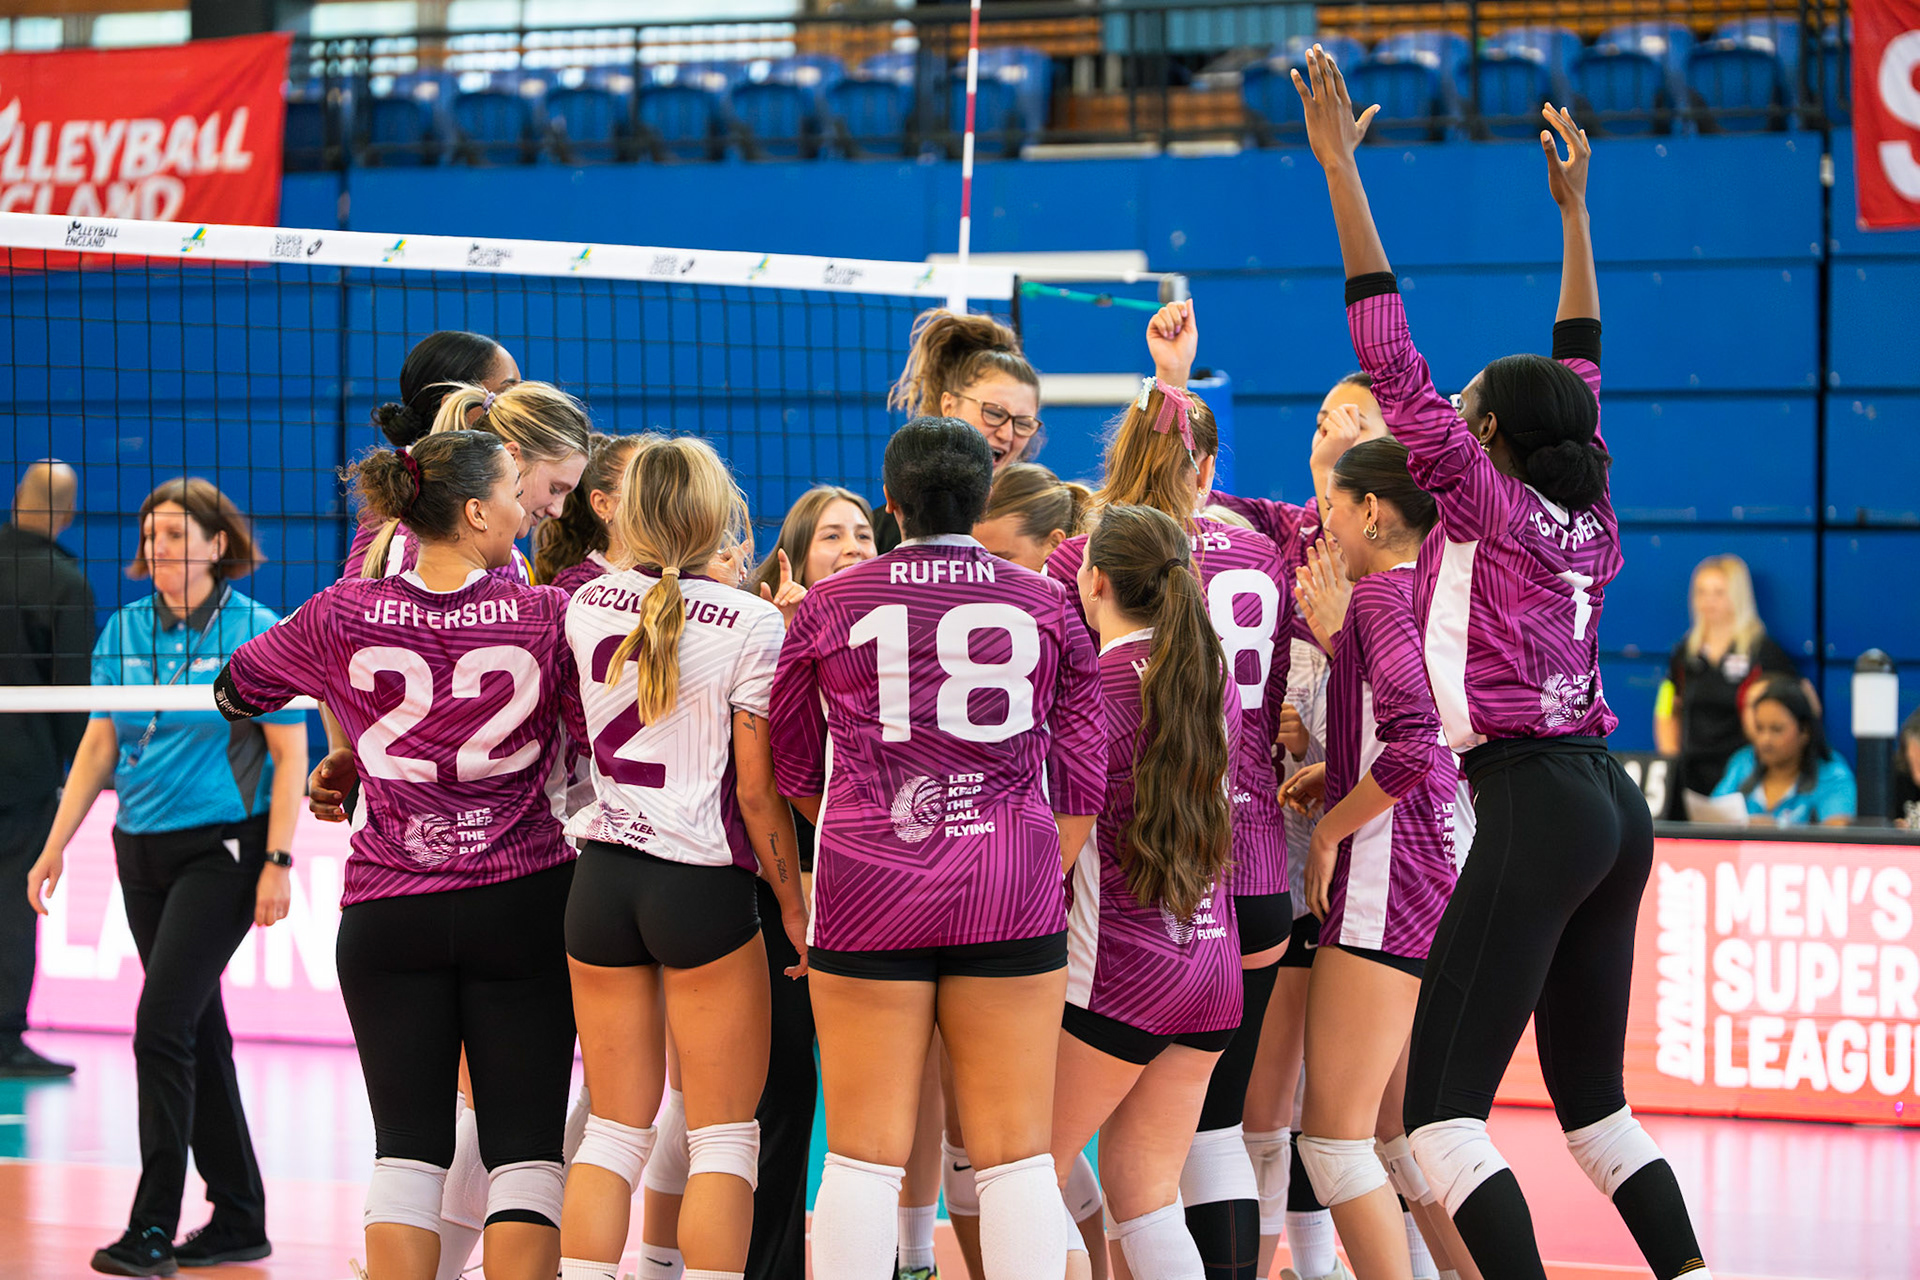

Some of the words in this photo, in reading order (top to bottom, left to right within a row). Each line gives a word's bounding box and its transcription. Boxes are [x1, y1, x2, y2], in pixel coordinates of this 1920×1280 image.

[0, 107, 251, 184] LLEYBALL
[0, 173, 185, 222] GLAND
[890, 560, 996, 584] RUFFIN
[364, 598, 519, 629] JEFFERSON
[575, 585, 740, 629] MCCULUGH
[848, 602, 1041, 744] 18
[348, 645, 542, 783] 22
[592, 634, 666, 789] 2
[949, 772, 984, 785] LETS
[944, 809, 980, 822] BALL
[946, 799, 973, 811] THE
[456, 830, 487, 842] THE
[623, 832, 649, 845] THE
[630, 821, 657, 836] KEE
[944, 821, 996, 838] FLYING
[1714, 861, 1913, 941] MEN'S
[1197, 926, 1227, 941] FLYING
[1712, 938, 1920, 1020] SUPER
[1713, 1014, 1920, 1096] LEAGU
